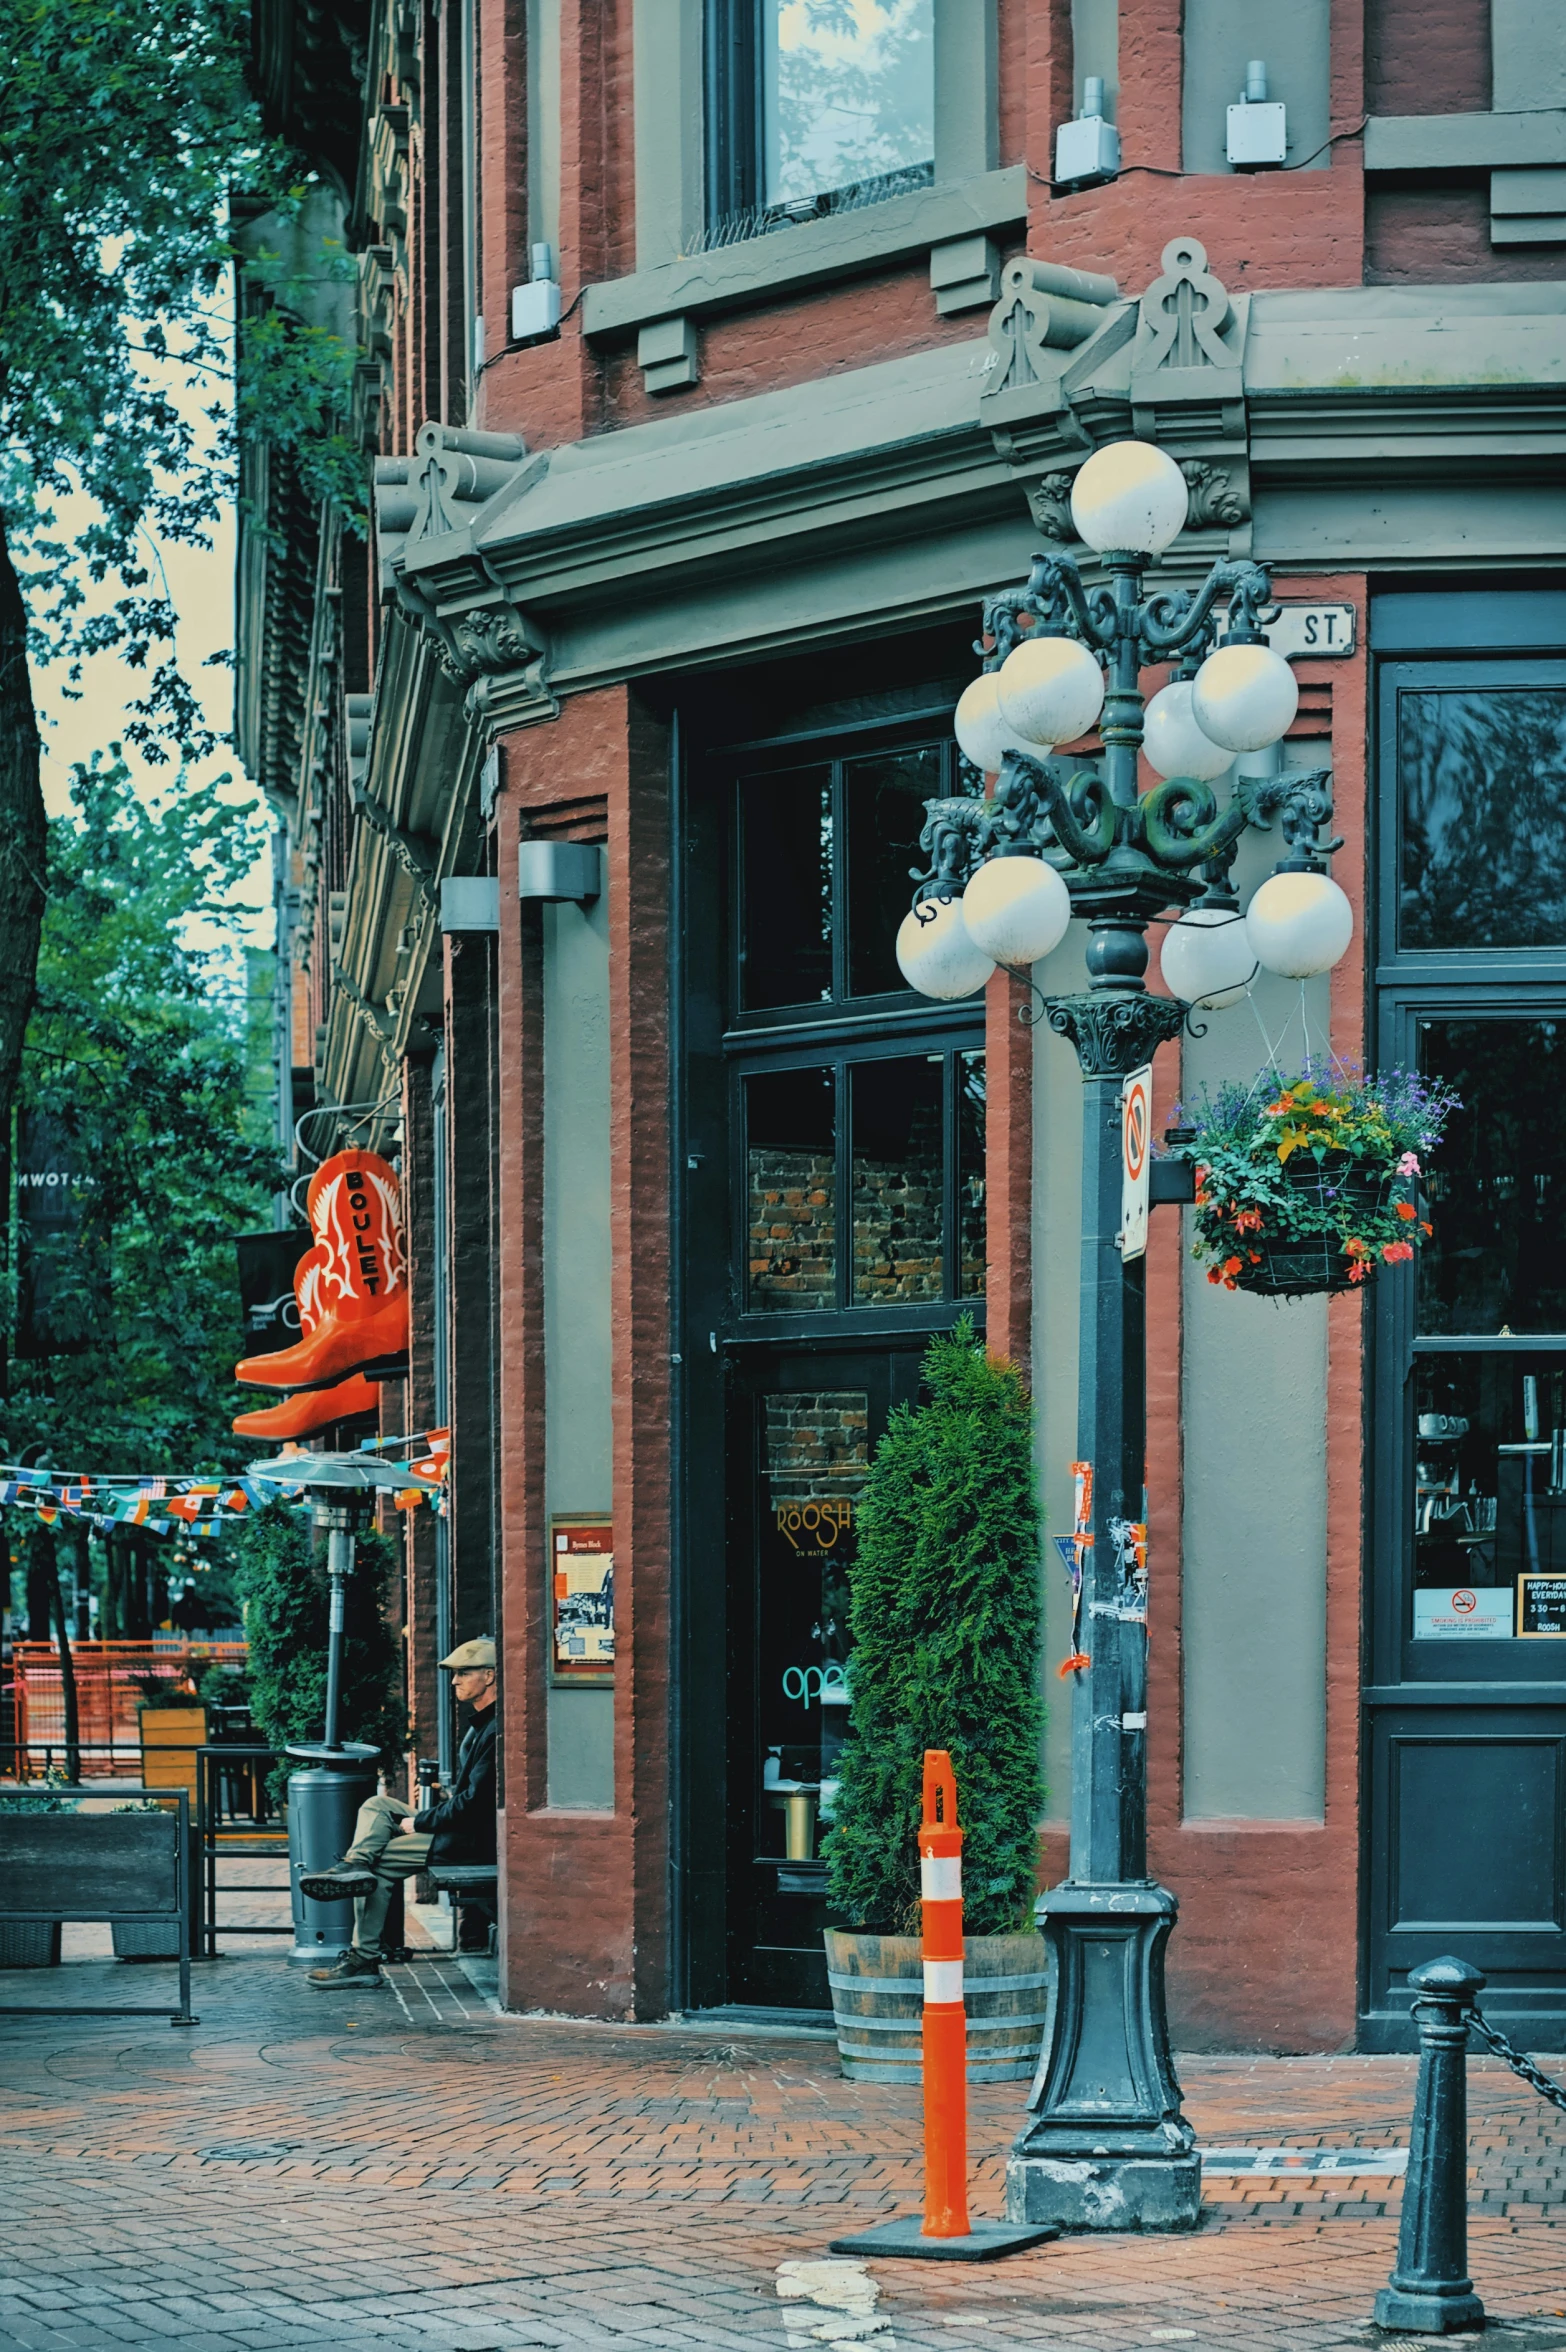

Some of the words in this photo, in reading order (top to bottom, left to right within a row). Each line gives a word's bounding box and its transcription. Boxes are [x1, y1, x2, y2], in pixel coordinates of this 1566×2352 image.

[1304, 614, 1344, 645] ST.
[345, 1171, 381, 1297] BOULET
[588, 1540, 601, 1548] Block
[807, 1549, 829, 1557] WATER
[1537, 1622, 1561, 1632] ROOSH
